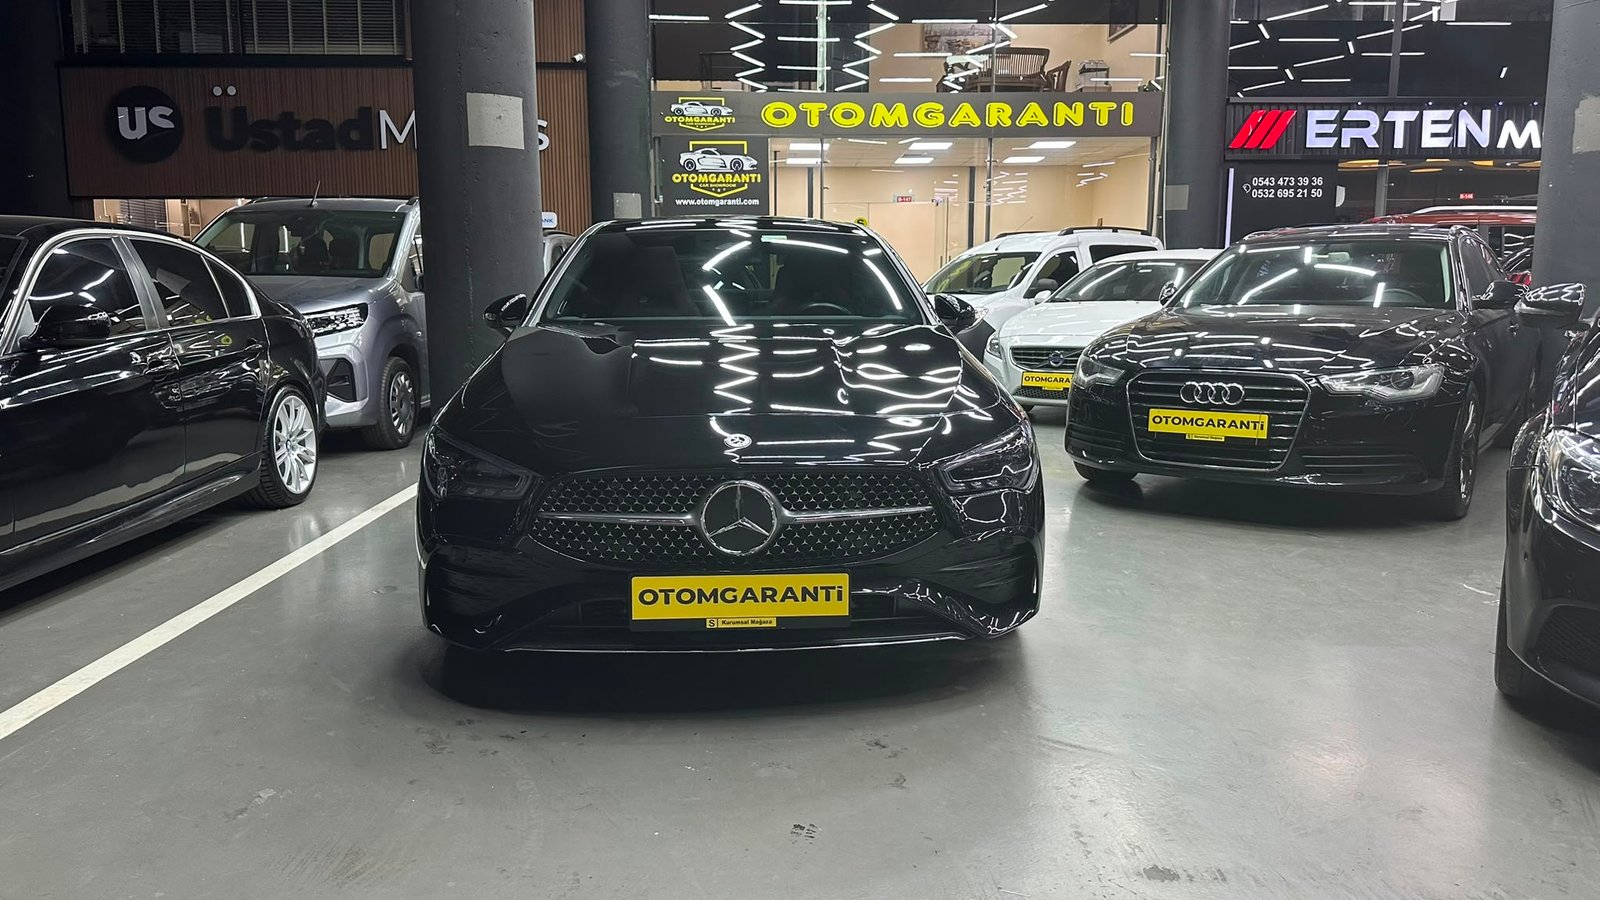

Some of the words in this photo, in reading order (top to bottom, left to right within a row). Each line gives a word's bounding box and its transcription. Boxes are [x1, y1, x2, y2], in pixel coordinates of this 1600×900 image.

[761, 102, 1133, 127] OTOMGARANTI
[1305, 109, 1491, 148] ERTEN
[1496, 119, 1542, 149] M
[672, 173, 761, 183] OTOMGARANTI
[1252, 177, 1275, 186] 0543
[1277, 177, 1295, 186] 473
[1297, 176, 1309, 186] 39
[1311, 176, 1324, 186] 36
[1251, 189, 1275, 198] 0532
[1277, 189, 1295, 198] 695
[1296, 188, 1308, 198] 21
[1310, 188, 1323, 198] 50
[675, 198, 760, 207] www.otomgaranti.com
[1024, 376, 1071, 384] OTOMGARA
[750, 618, 773, 626] Mağaza
